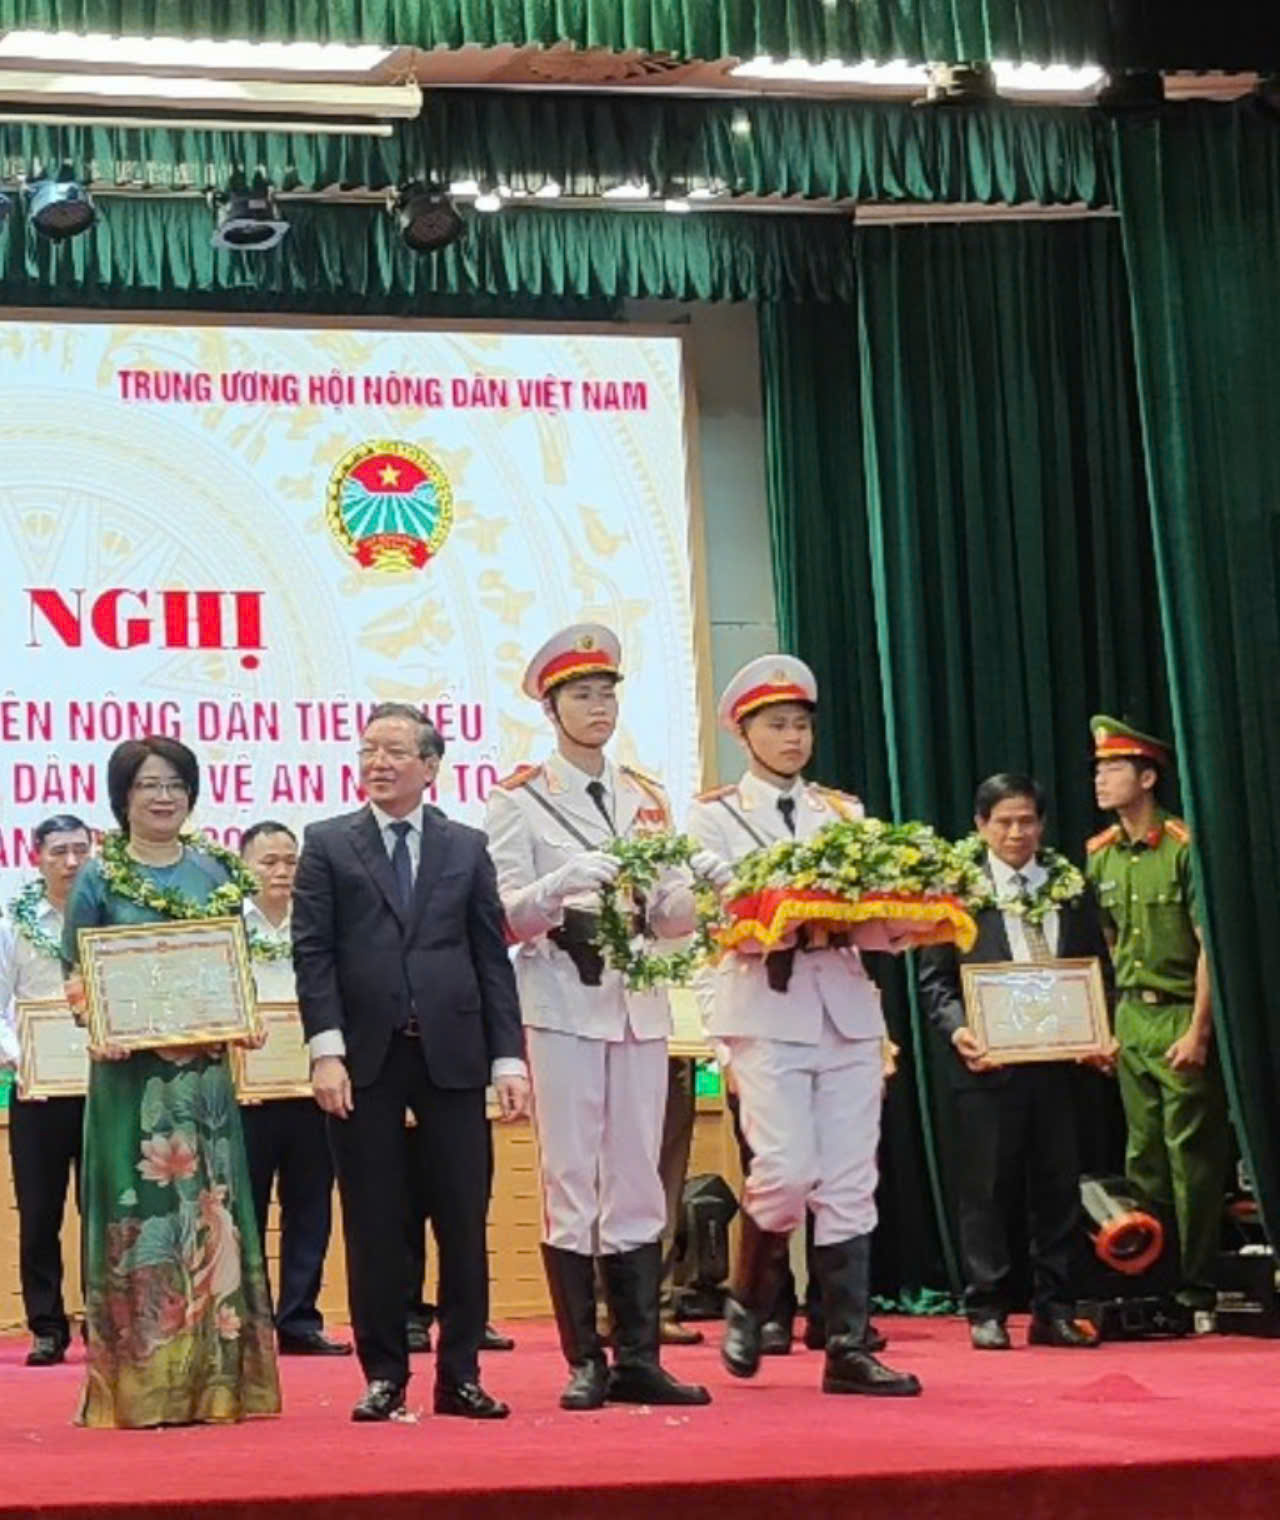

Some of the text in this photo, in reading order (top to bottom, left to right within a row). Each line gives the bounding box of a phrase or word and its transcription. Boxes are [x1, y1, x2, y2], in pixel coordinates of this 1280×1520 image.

[118, 368, 647, 415] TRUNG ƯƠNG HỘI NÔNG DÂN VIỆT NAM
[23, 587, 267, 669] NGHỊ
[69, 690, 180, 742] NÔNG
[198, 692, 279, 741] DÂN
[13, 753, 96, 803] DÂN
[208, 754, 254, 813] VỆ
[272, 764, 325, 803] AN
